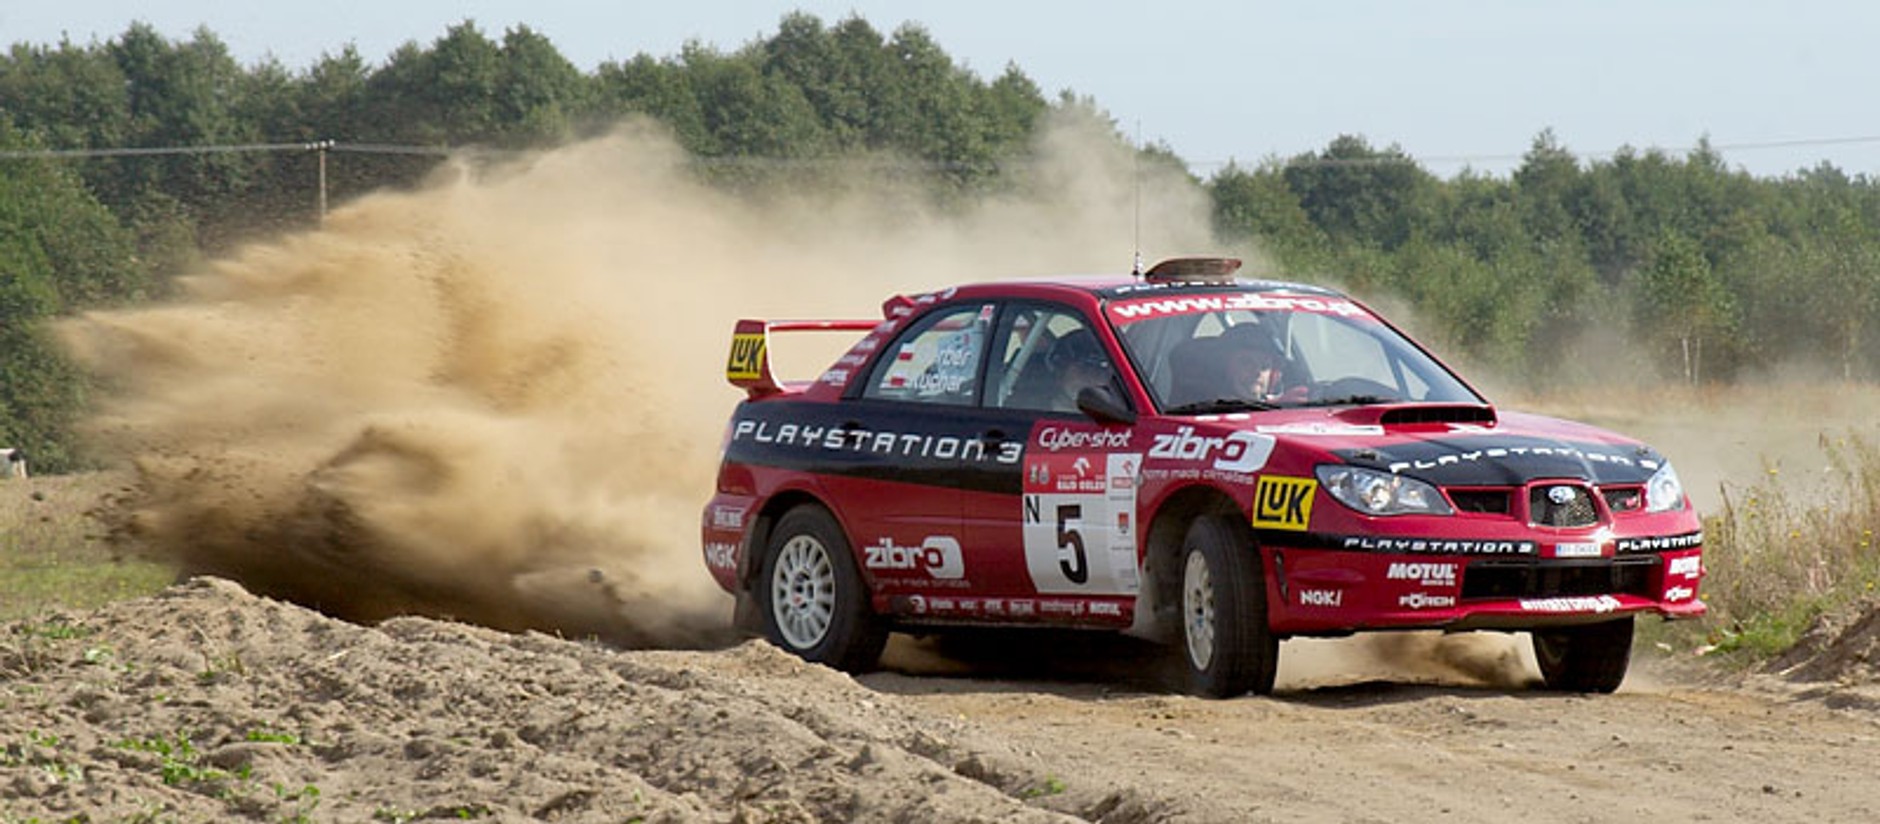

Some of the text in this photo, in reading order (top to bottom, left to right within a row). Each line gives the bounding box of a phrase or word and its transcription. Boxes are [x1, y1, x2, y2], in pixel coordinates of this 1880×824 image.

[1114, 294, 1366, 317] www.zibro.pl
[733, 421, 1023, 463] PLAYSTATION 3
[1149, 426, 1276, 473] zibro
[1389, 448, 1634, 473] PLAYSTATION
[1025, 496, 1040, 524] N
[1057, 504, 1088, 584] 5
[1344, 538, 1514, 553] PLAYSTATION
[865, 538, 964, 579] zibro
[1387, 563, 1456, 579] MOTUL
